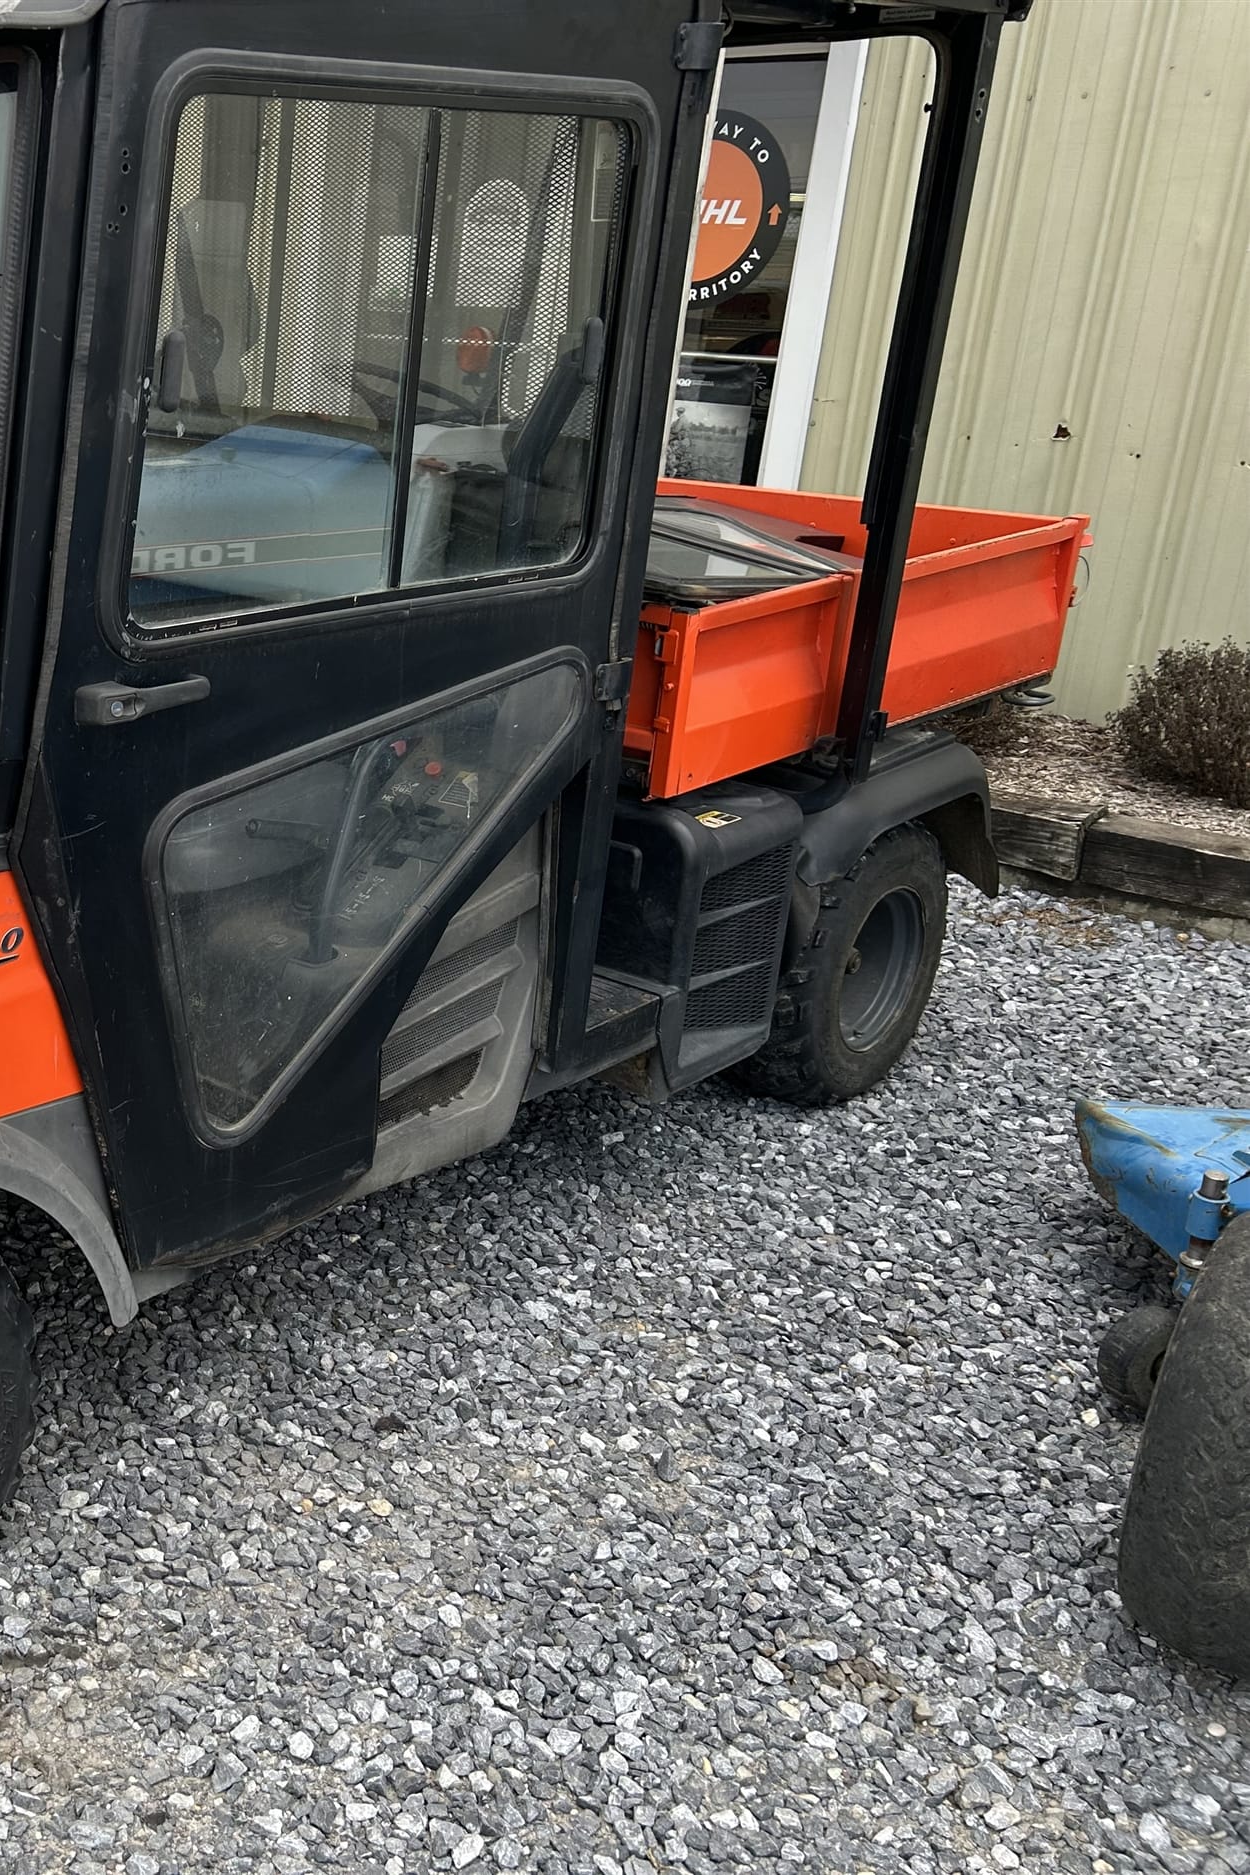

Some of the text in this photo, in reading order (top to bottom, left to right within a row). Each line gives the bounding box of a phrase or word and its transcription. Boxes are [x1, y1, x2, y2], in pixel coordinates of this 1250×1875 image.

[714, 121, 770, 163] AY TO
[688, 248, 762, 302] RRITORY
